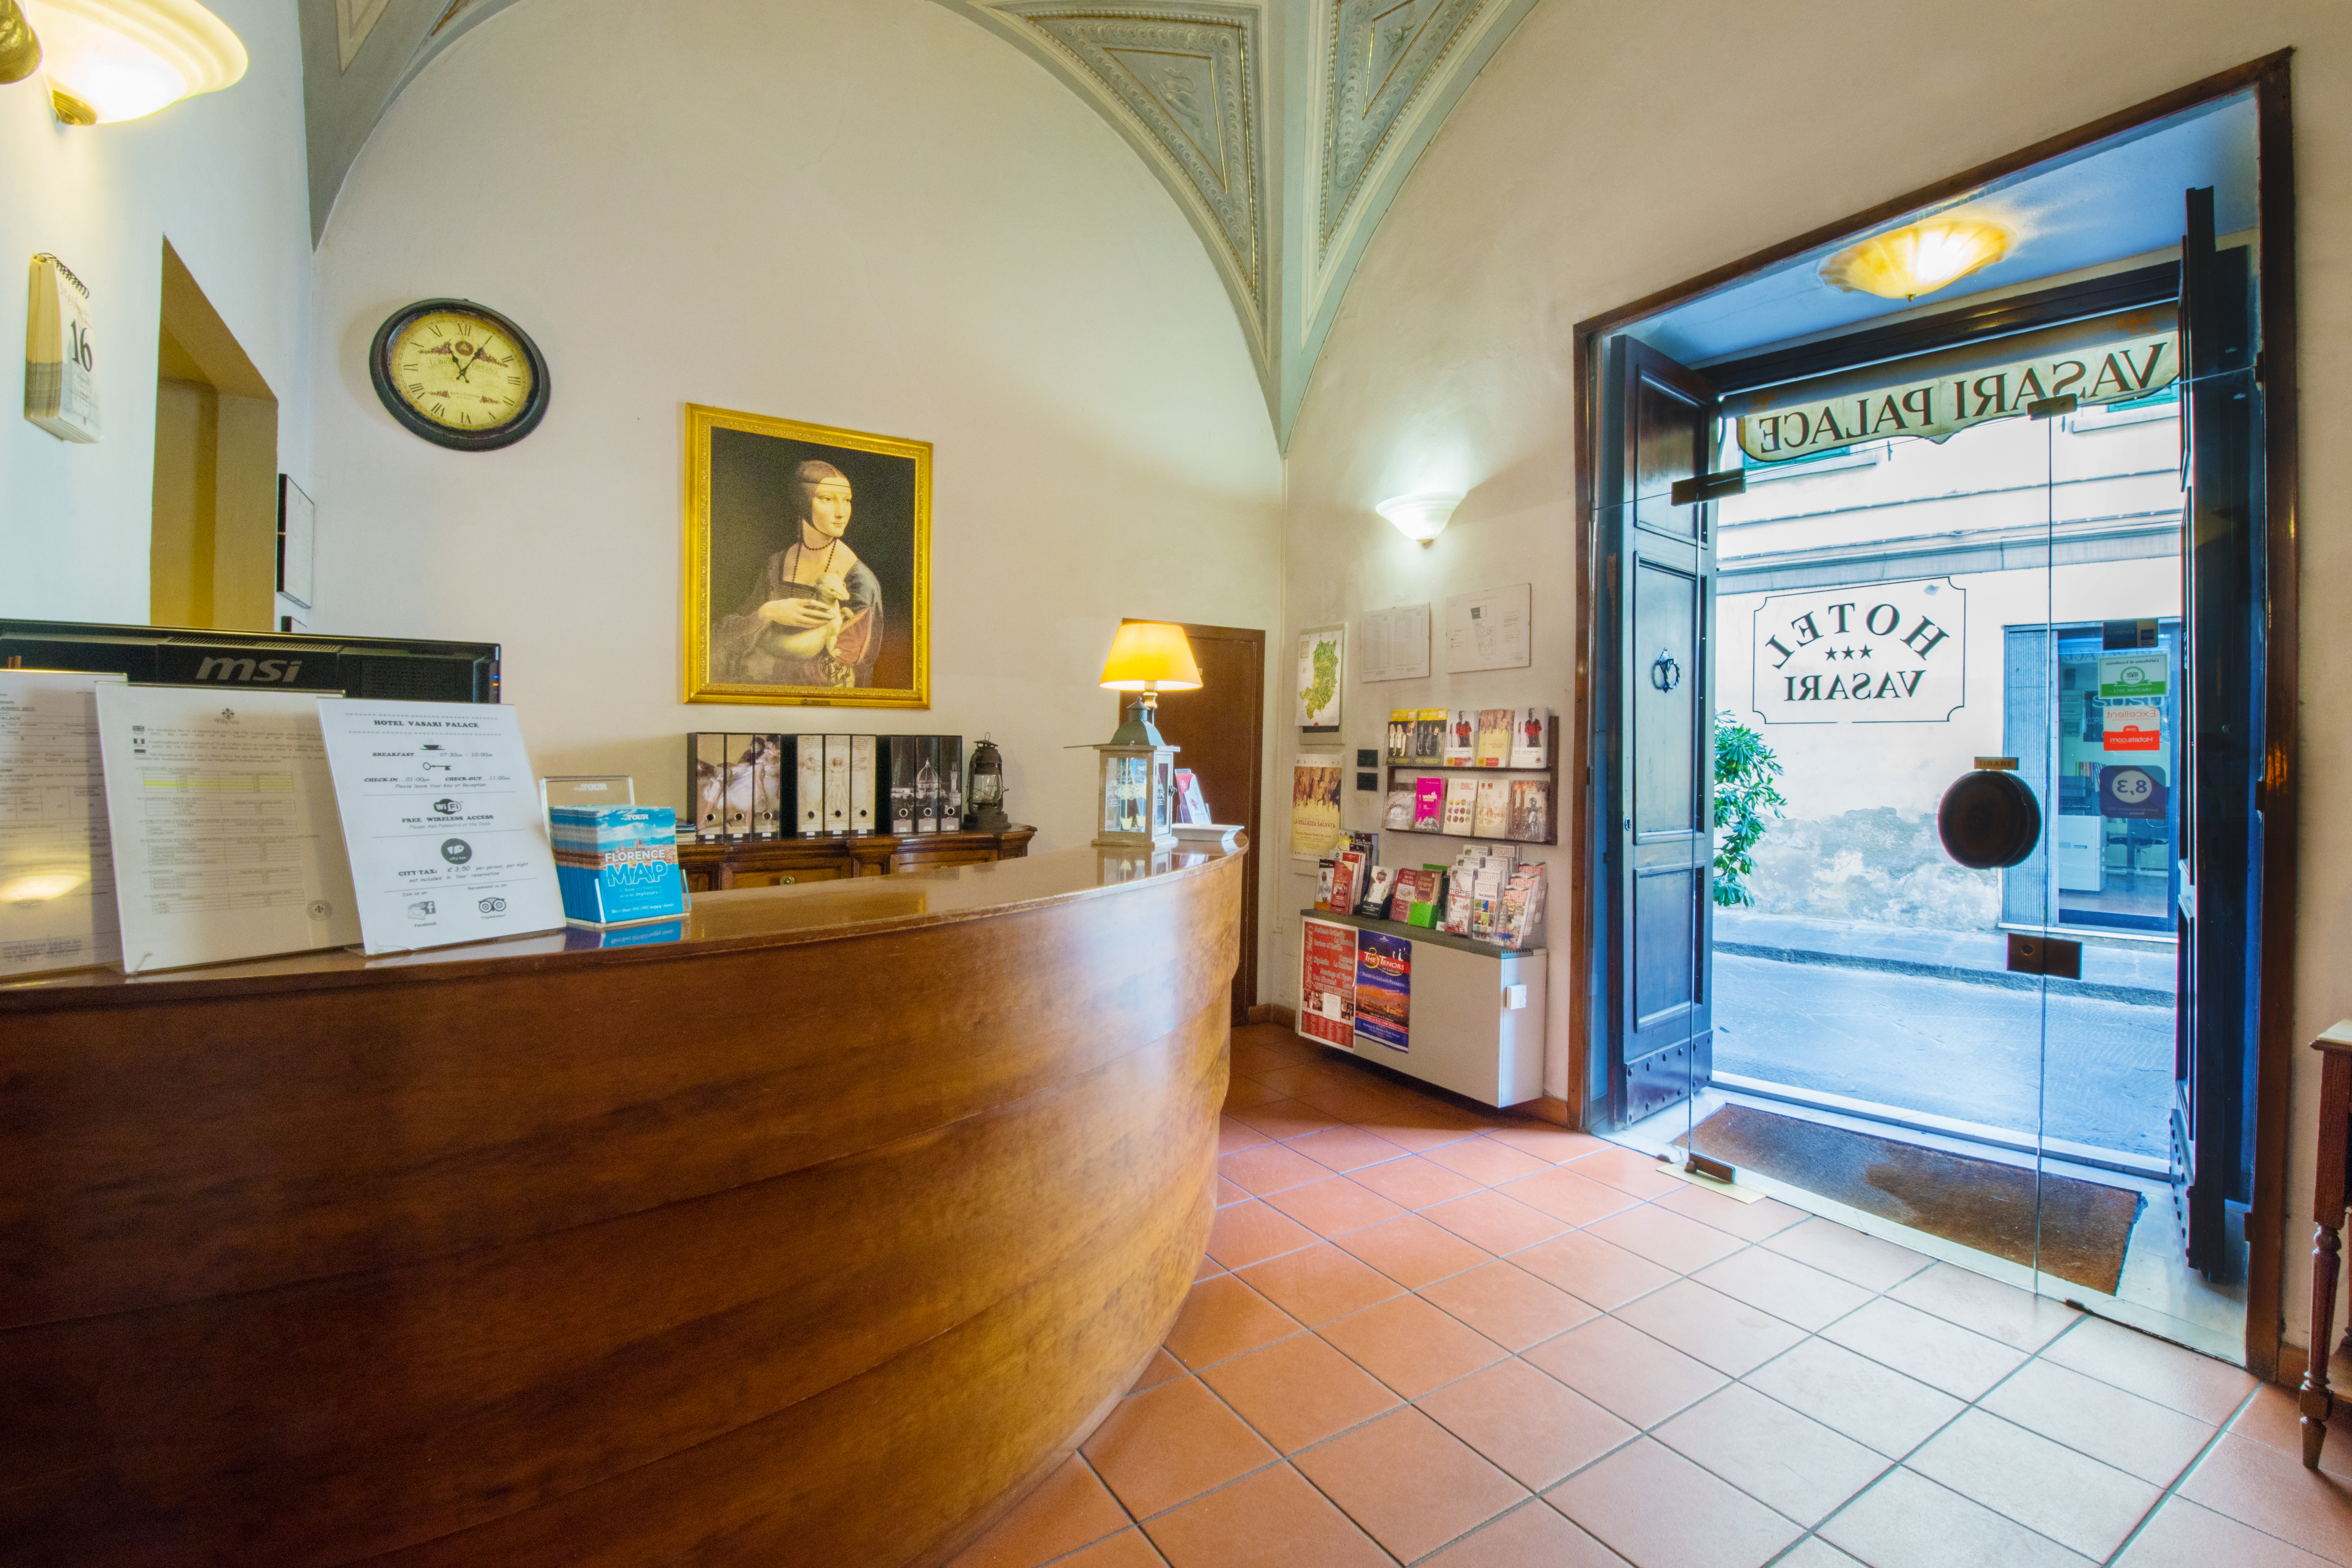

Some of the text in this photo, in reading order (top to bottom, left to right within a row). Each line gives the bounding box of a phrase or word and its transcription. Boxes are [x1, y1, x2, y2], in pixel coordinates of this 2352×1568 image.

[70, 318, 93, 372] 16
[196, 656, 303, 683] msi
[574, 783, 608, 792] myTOUR
[605, 849, 665, 862] FLORENCE
[606, 860, 668, 887] MAP
[1479, 873, 1500, 881] TOURS
[1476, 885, 1497, 893] TOURS
[1379, 955, 1404, 970] TENORS
